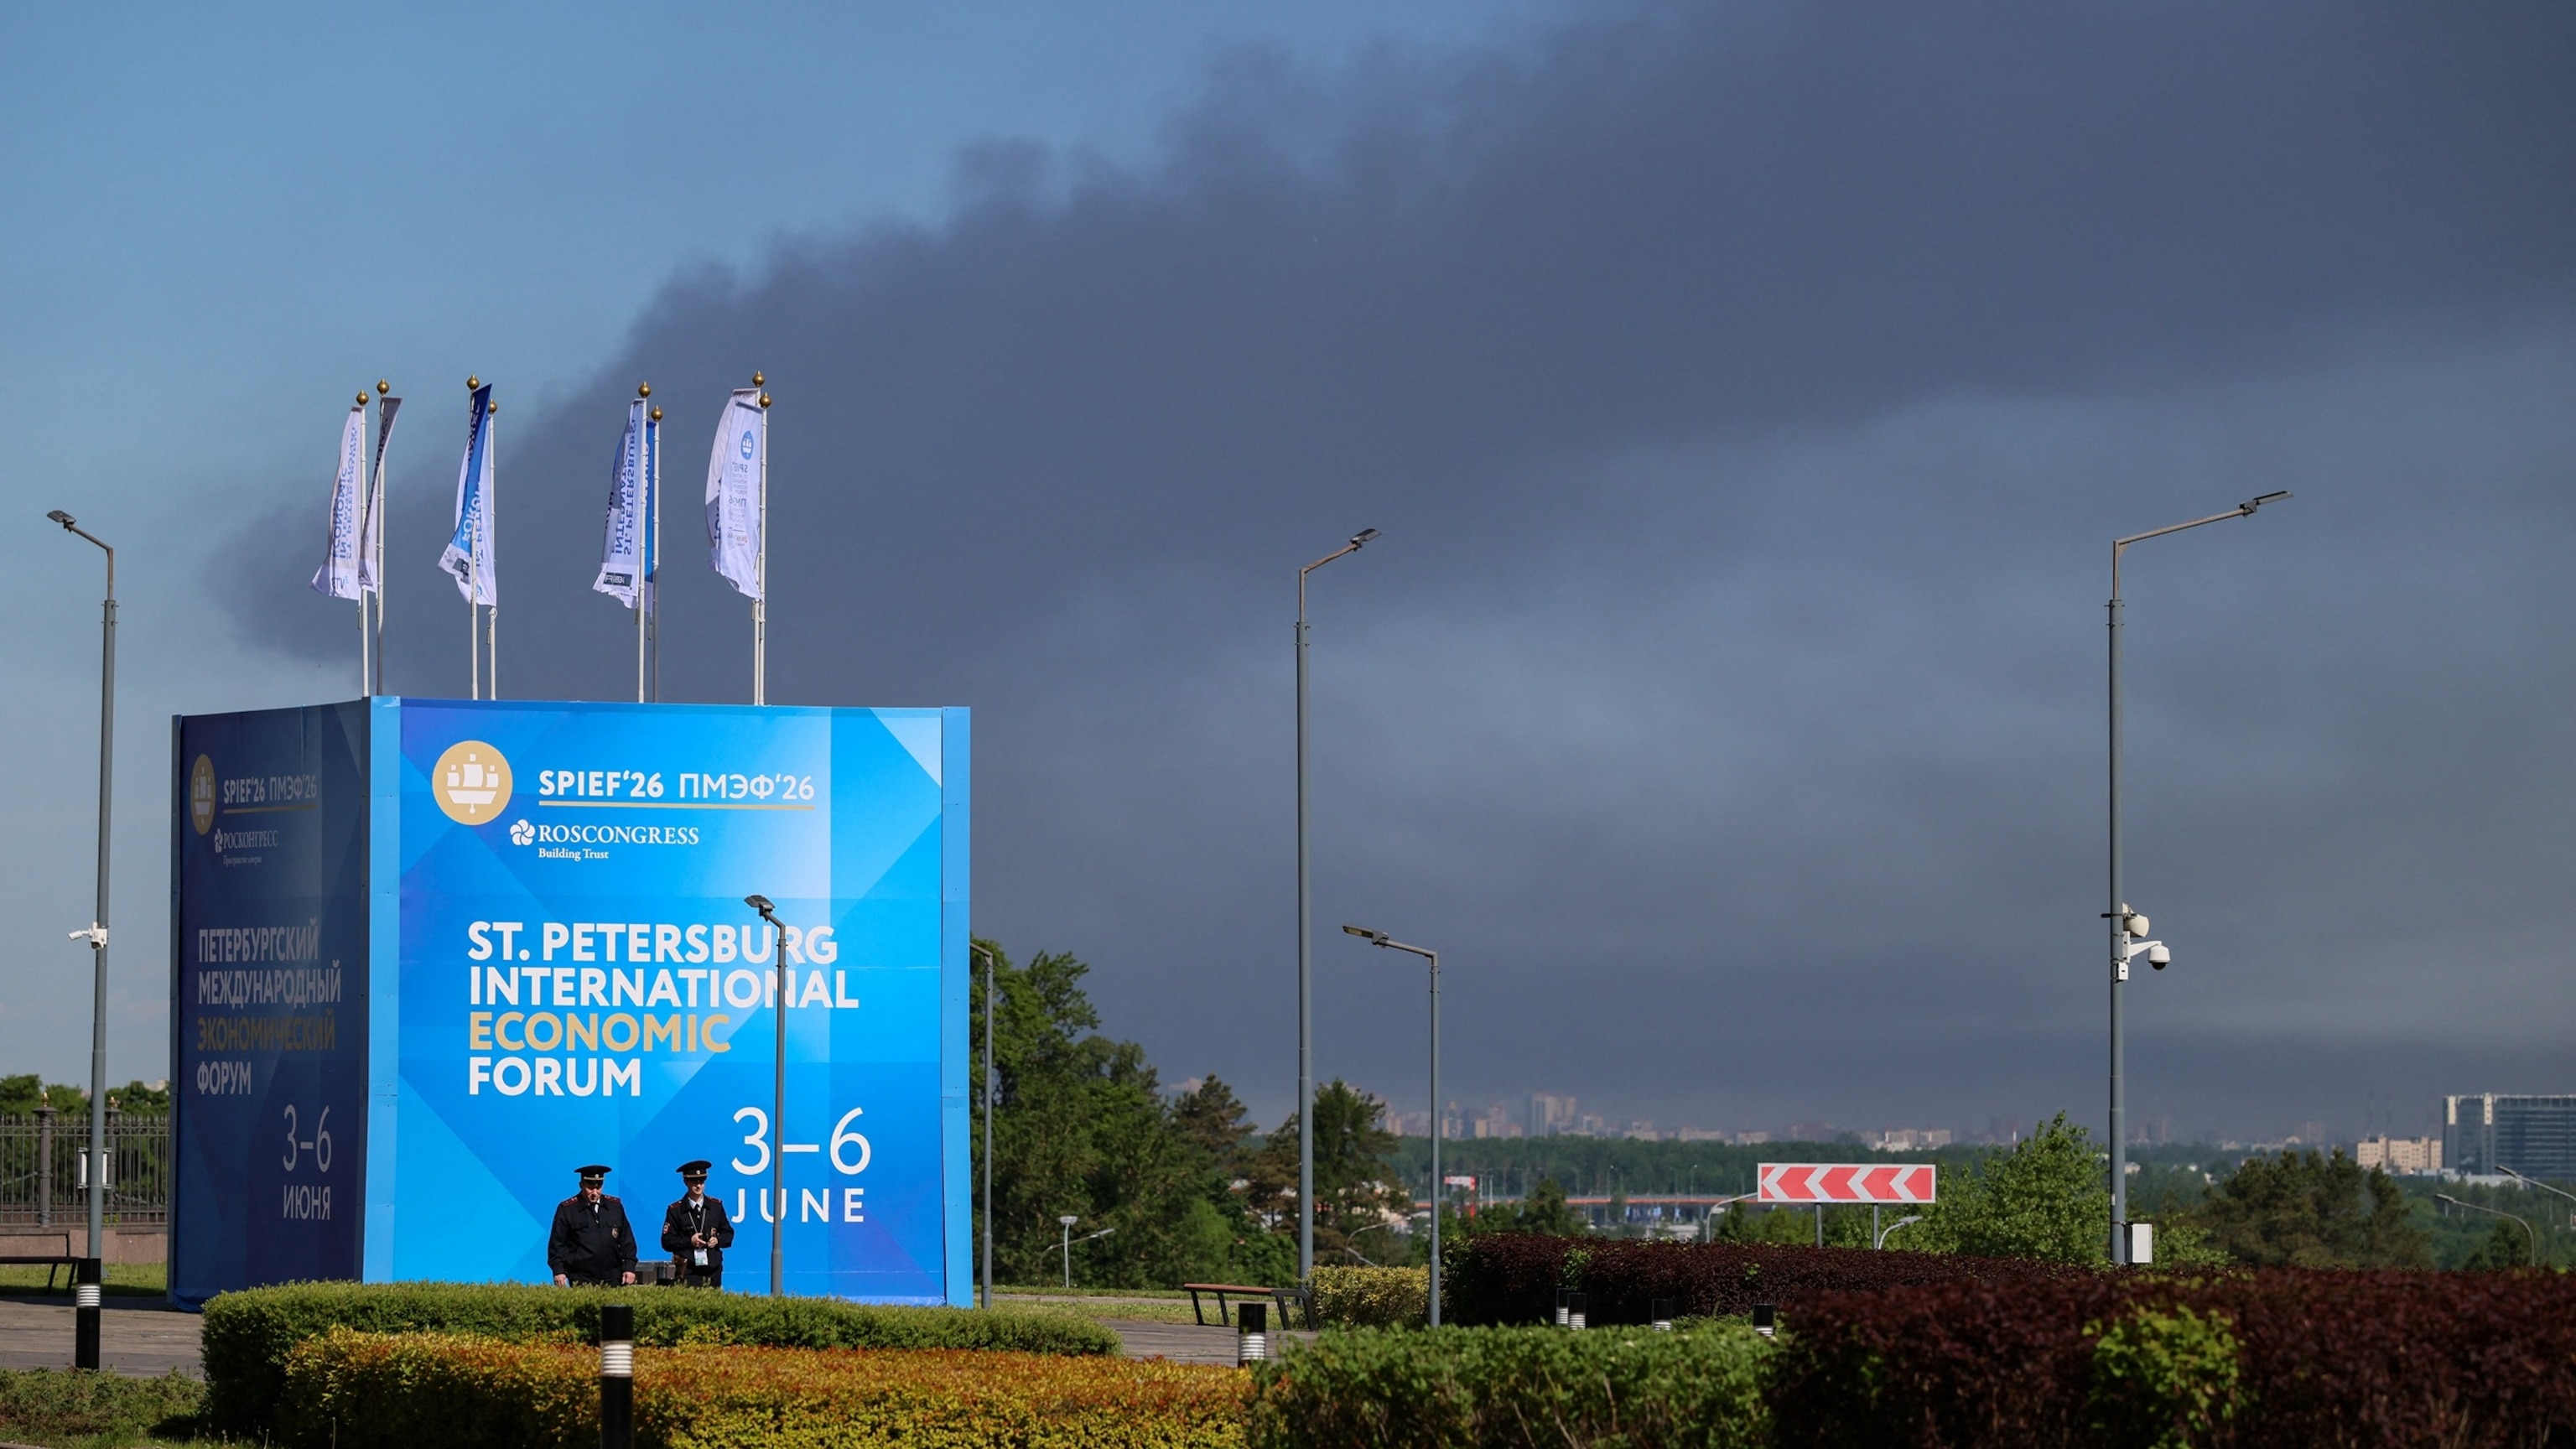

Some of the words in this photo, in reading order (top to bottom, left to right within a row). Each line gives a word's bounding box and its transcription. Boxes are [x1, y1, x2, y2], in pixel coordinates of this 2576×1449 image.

[223, 830, 278, 849] РОСКОНГРЕСС
[538, 824, 699, 845] ROSCONGRESS
[538, 848, 581, 861] Building
[583, 849, 609, 860] Trust
[199, 917, 319, 963] ПЕТЕРБУРГСКИЙ
[467, 921, 530, 961] ST.
[543, 922, 838, 964] PETERSBURG
[198, 959, 341, 1009] МЕЖДУНАРОДНЫЙ
[469, 966, 860, 1008] INTERNATIONAL
[197, 1008, 335, 1051] ЭКОНОМИЧЕСКИЙ
[469, 1011, 732, 1052] ECONOMIC
[197, 1061, 252, 1094] ФОРУМ
[469, 1057, 641, 1097] FORUM
[283, 1185, 331, 1220] ИЮНЯ
[730, 1187, 865, 1223] JUNE
